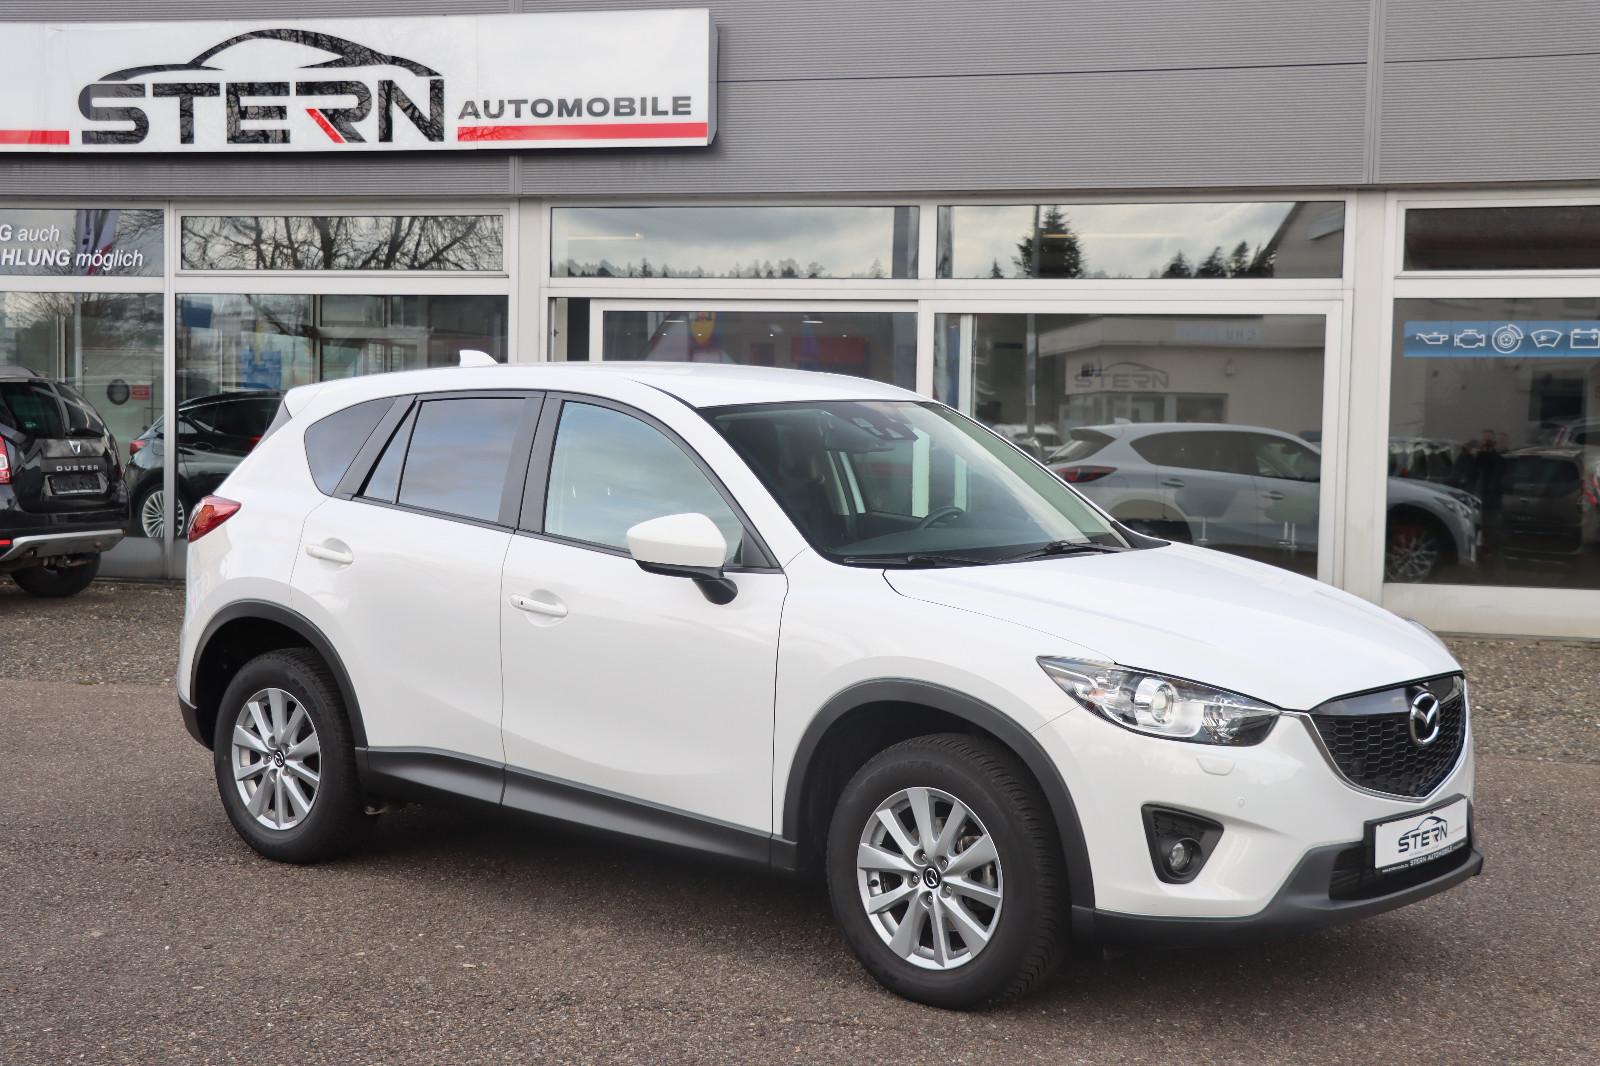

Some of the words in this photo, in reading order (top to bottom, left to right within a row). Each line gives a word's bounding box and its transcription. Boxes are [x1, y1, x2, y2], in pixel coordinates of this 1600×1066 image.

[78, 79, 444, 144] STERN
[457, 96, 692, 120] AUTOMOBILE
[17, 226, 60, 242] auch
[75, 250, 144, 271] möglich
[55, 464, 99, 473] DUSTER
[1398, 824, 1448, 853] STERN
